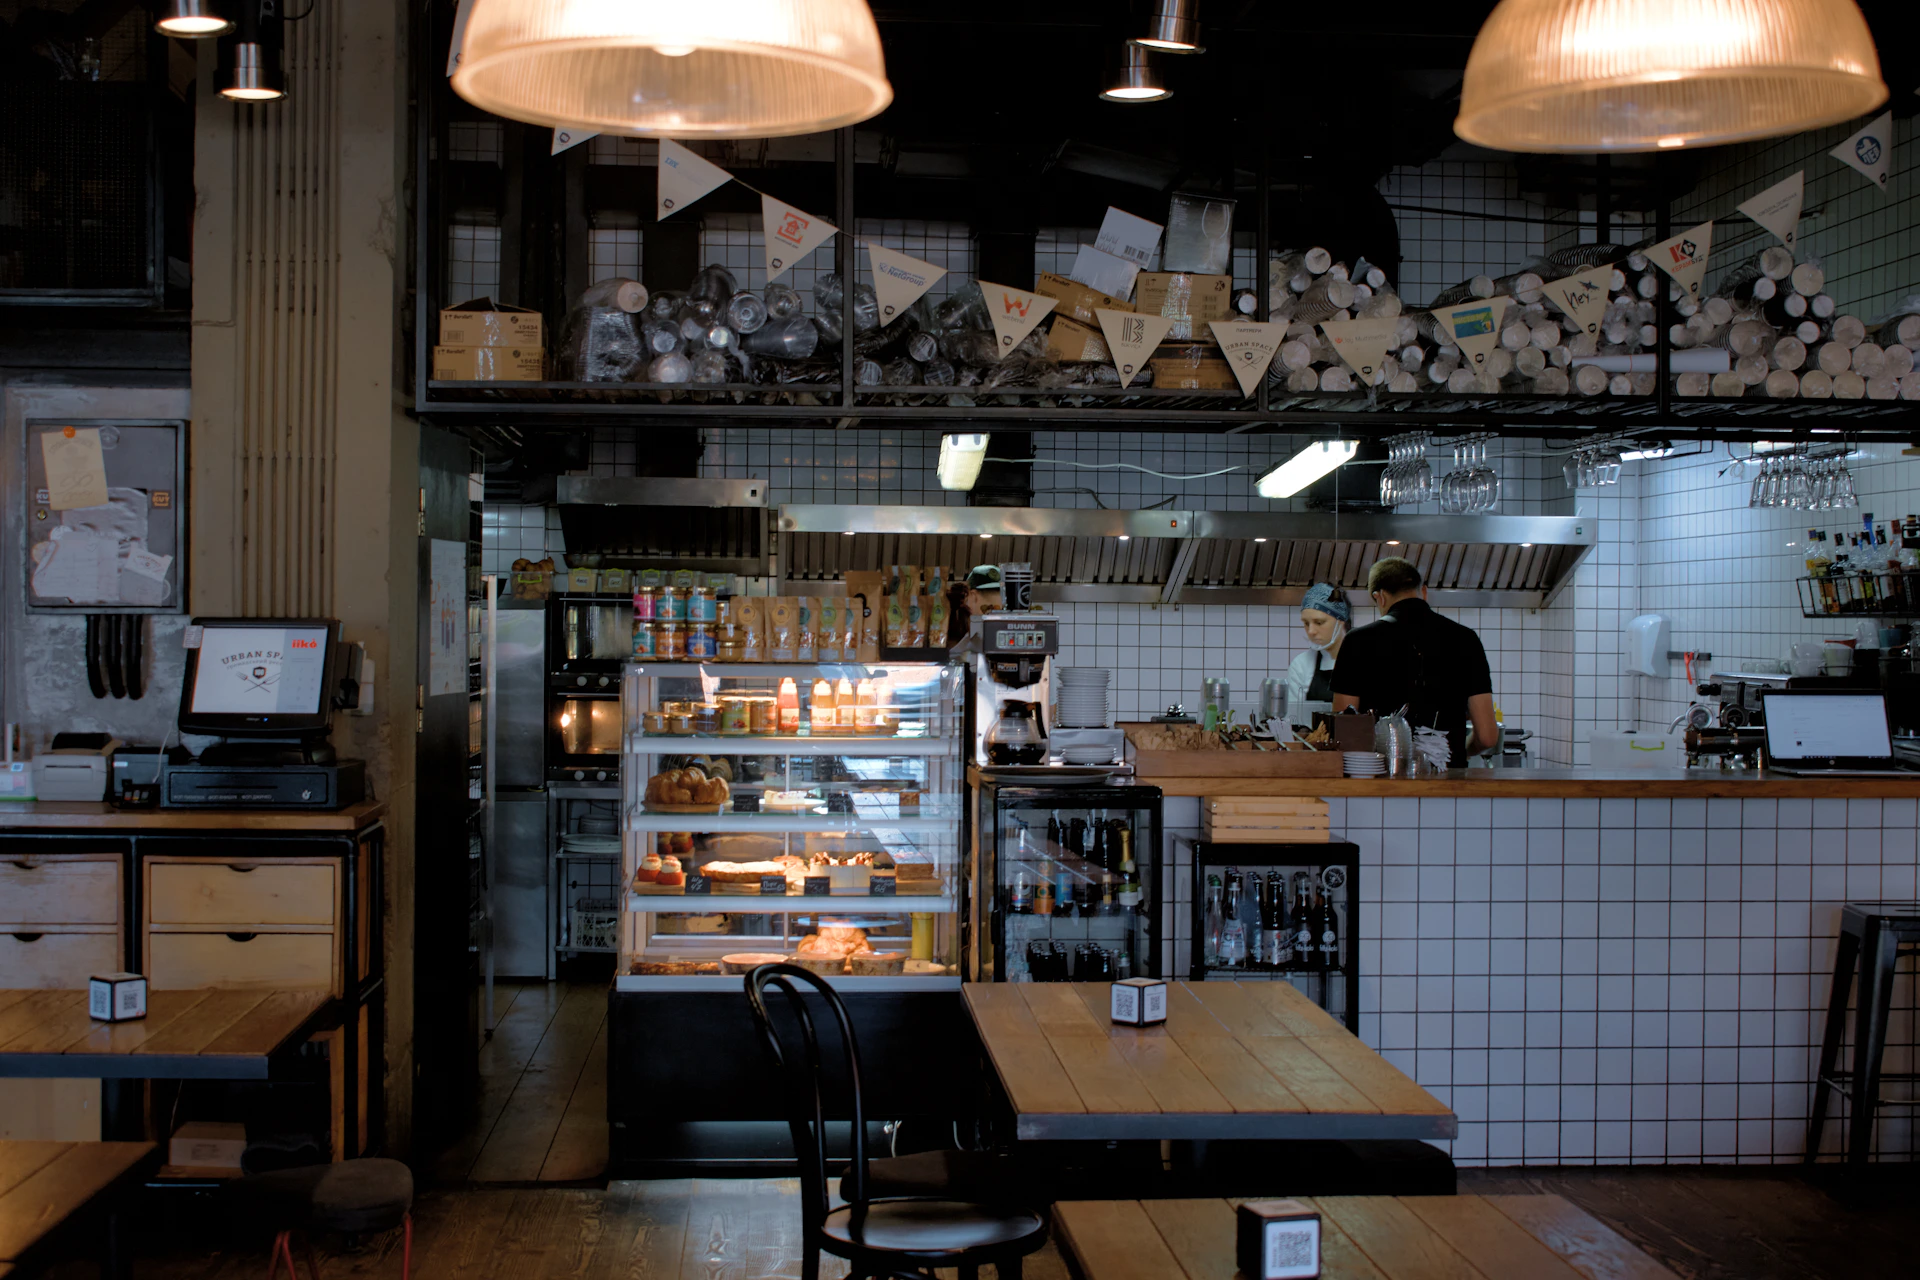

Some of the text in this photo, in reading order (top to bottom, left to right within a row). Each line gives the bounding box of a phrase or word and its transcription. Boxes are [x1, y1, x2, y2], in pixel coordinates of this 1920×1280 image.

[887, 267, 924, 287] NetGroup
[1225, 341, 1249, 351] URBAN
[1251, 342, 1273, 352] SPACE
[291, 637, 318, 649] iiko
[221, 650, 263, 665] URBAN
